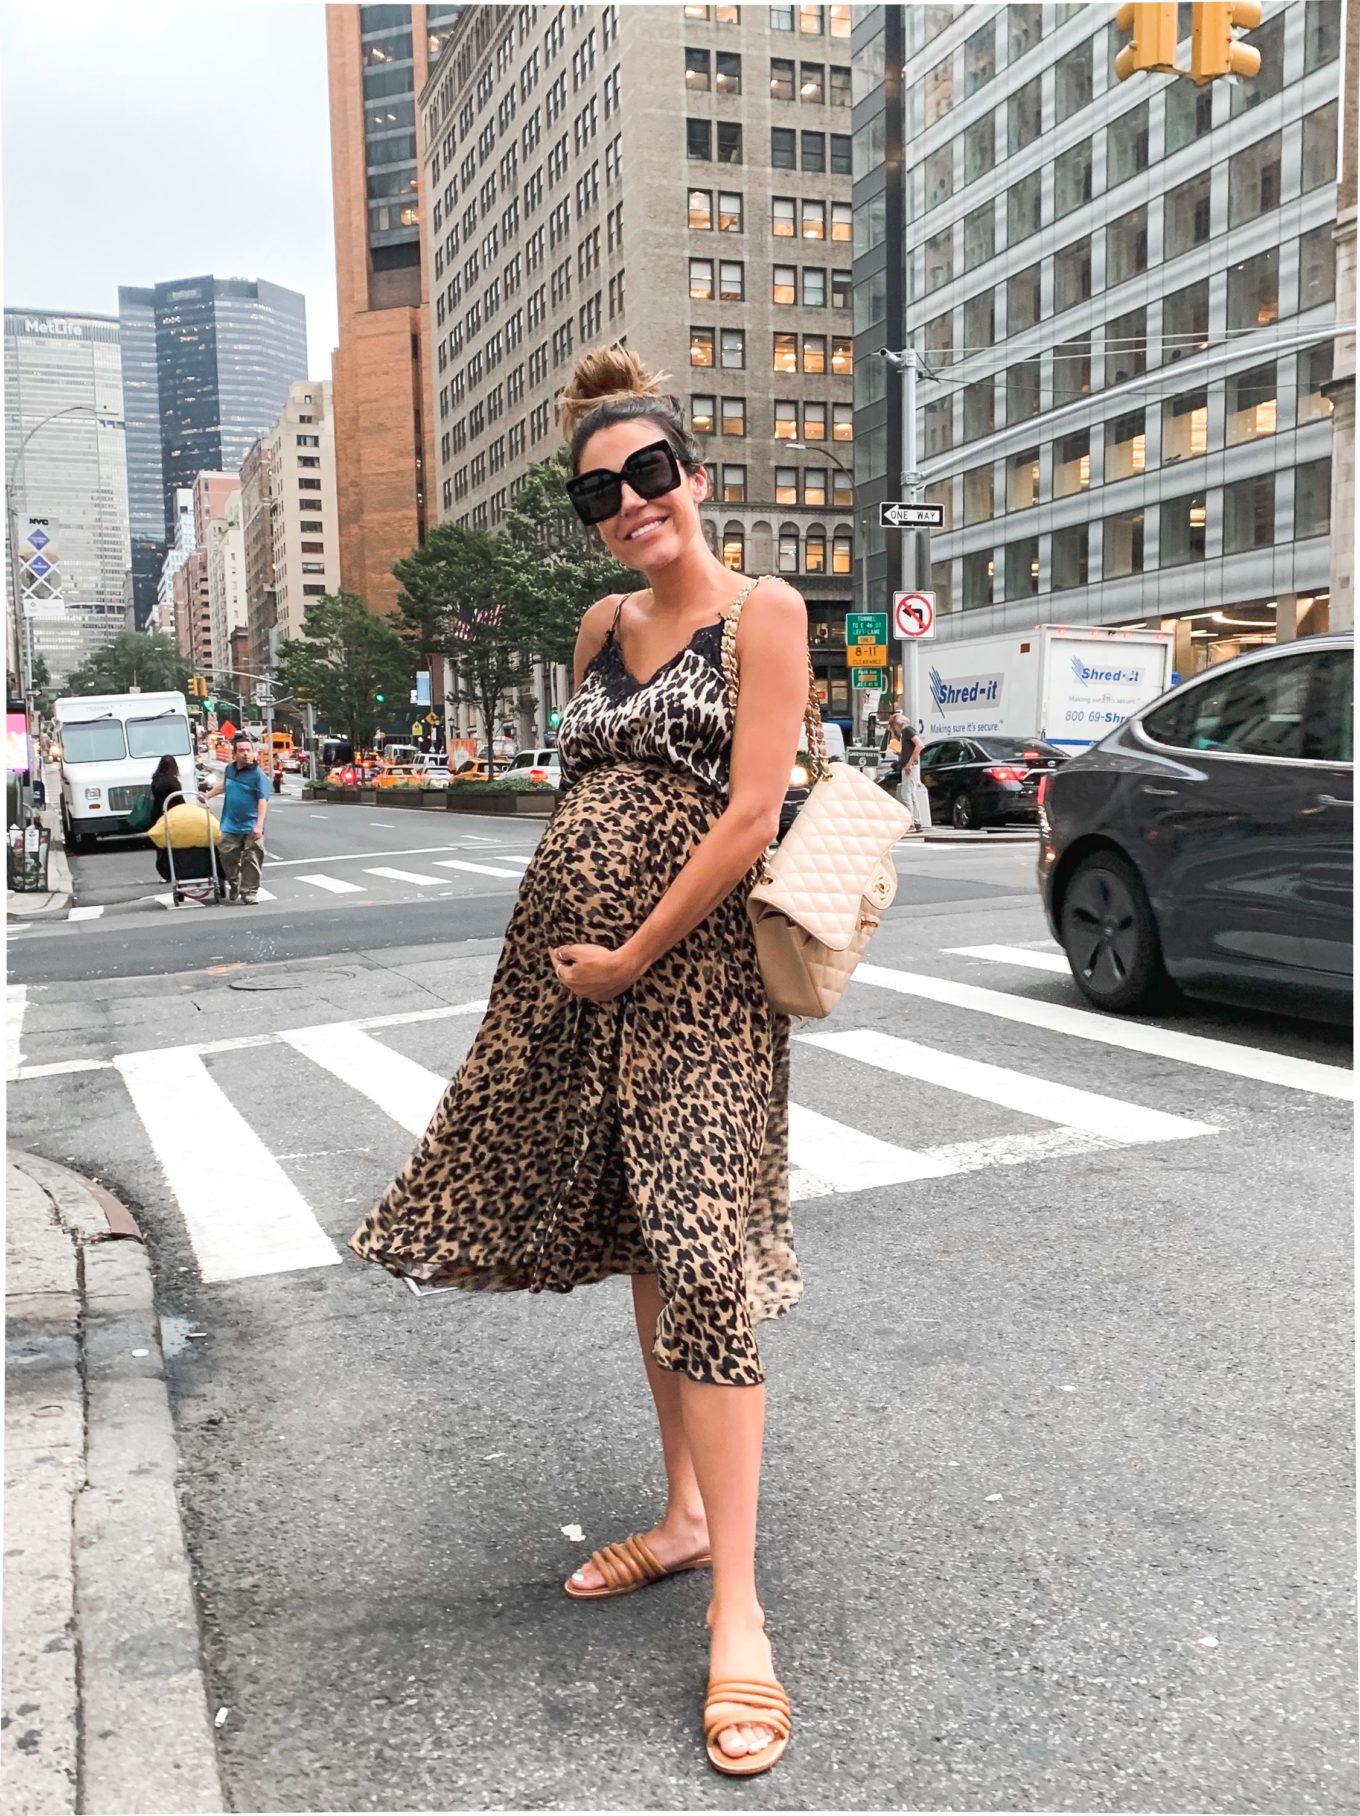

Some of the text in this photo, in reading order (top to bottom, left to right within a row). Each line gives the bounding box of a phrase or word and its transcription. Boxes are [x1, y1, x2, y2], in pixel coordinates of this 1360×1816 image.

[25, 319, 82, 335] MetLife
[891, 511, 936, 520] ONE WAY
[938, 681, 997, 704] Shred-it
[1065, 710, 1084, 721] 800
[930, 724, 951, 736] Making
[953, 724, 966, 732] sure
[967, 722, 976, 731] it's
